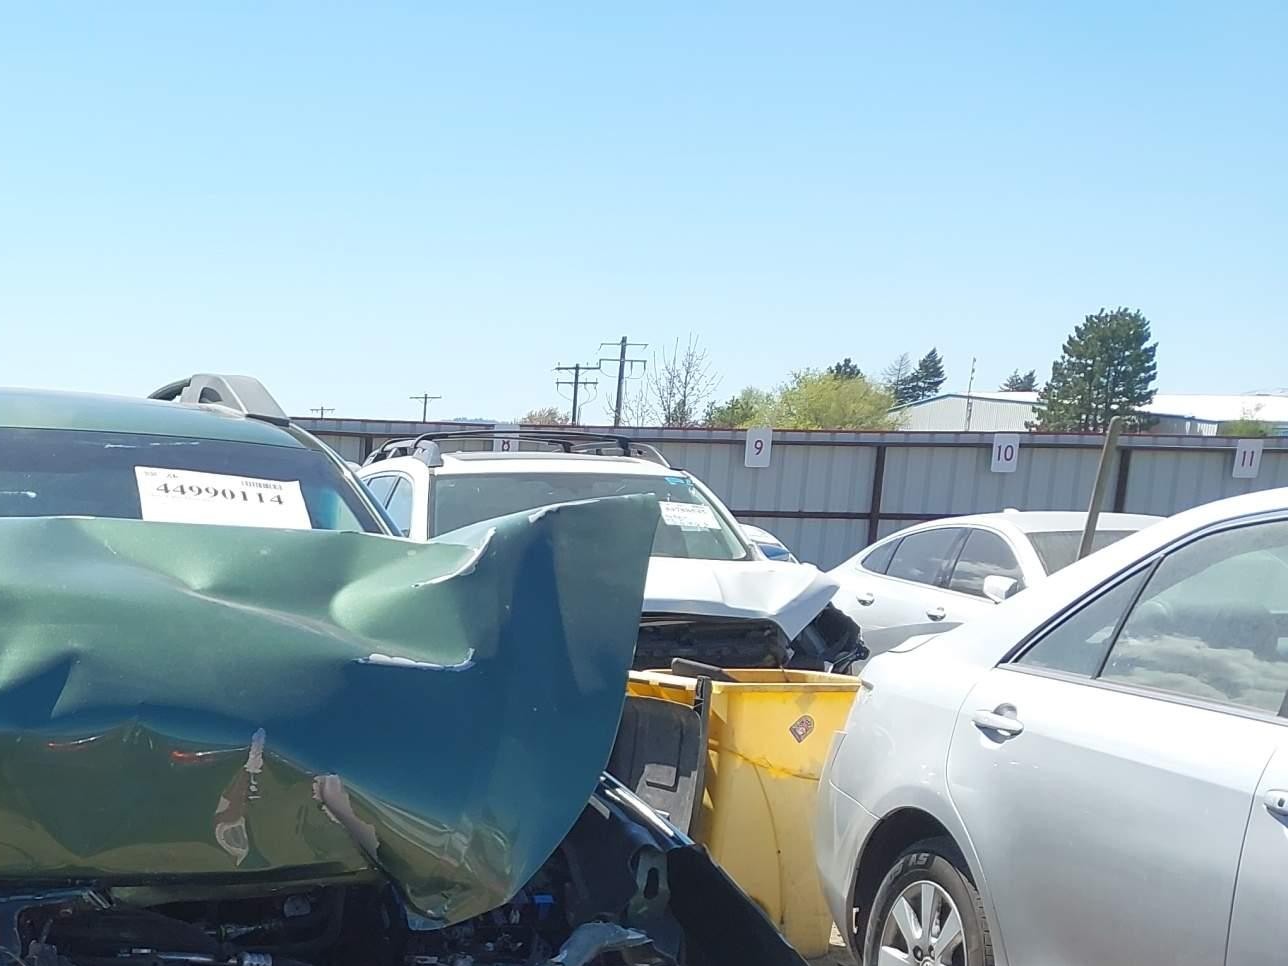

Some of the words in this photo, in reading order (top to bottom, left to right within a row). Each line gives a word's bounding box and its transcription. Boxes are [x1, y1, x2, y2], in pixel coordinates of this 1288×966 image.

[754, 440, 763, 455] 9
[997, 444, 1014, 461] 10
[1241, 450, 1254, 467] 11
[156, 483, 283, 505] 44990114
